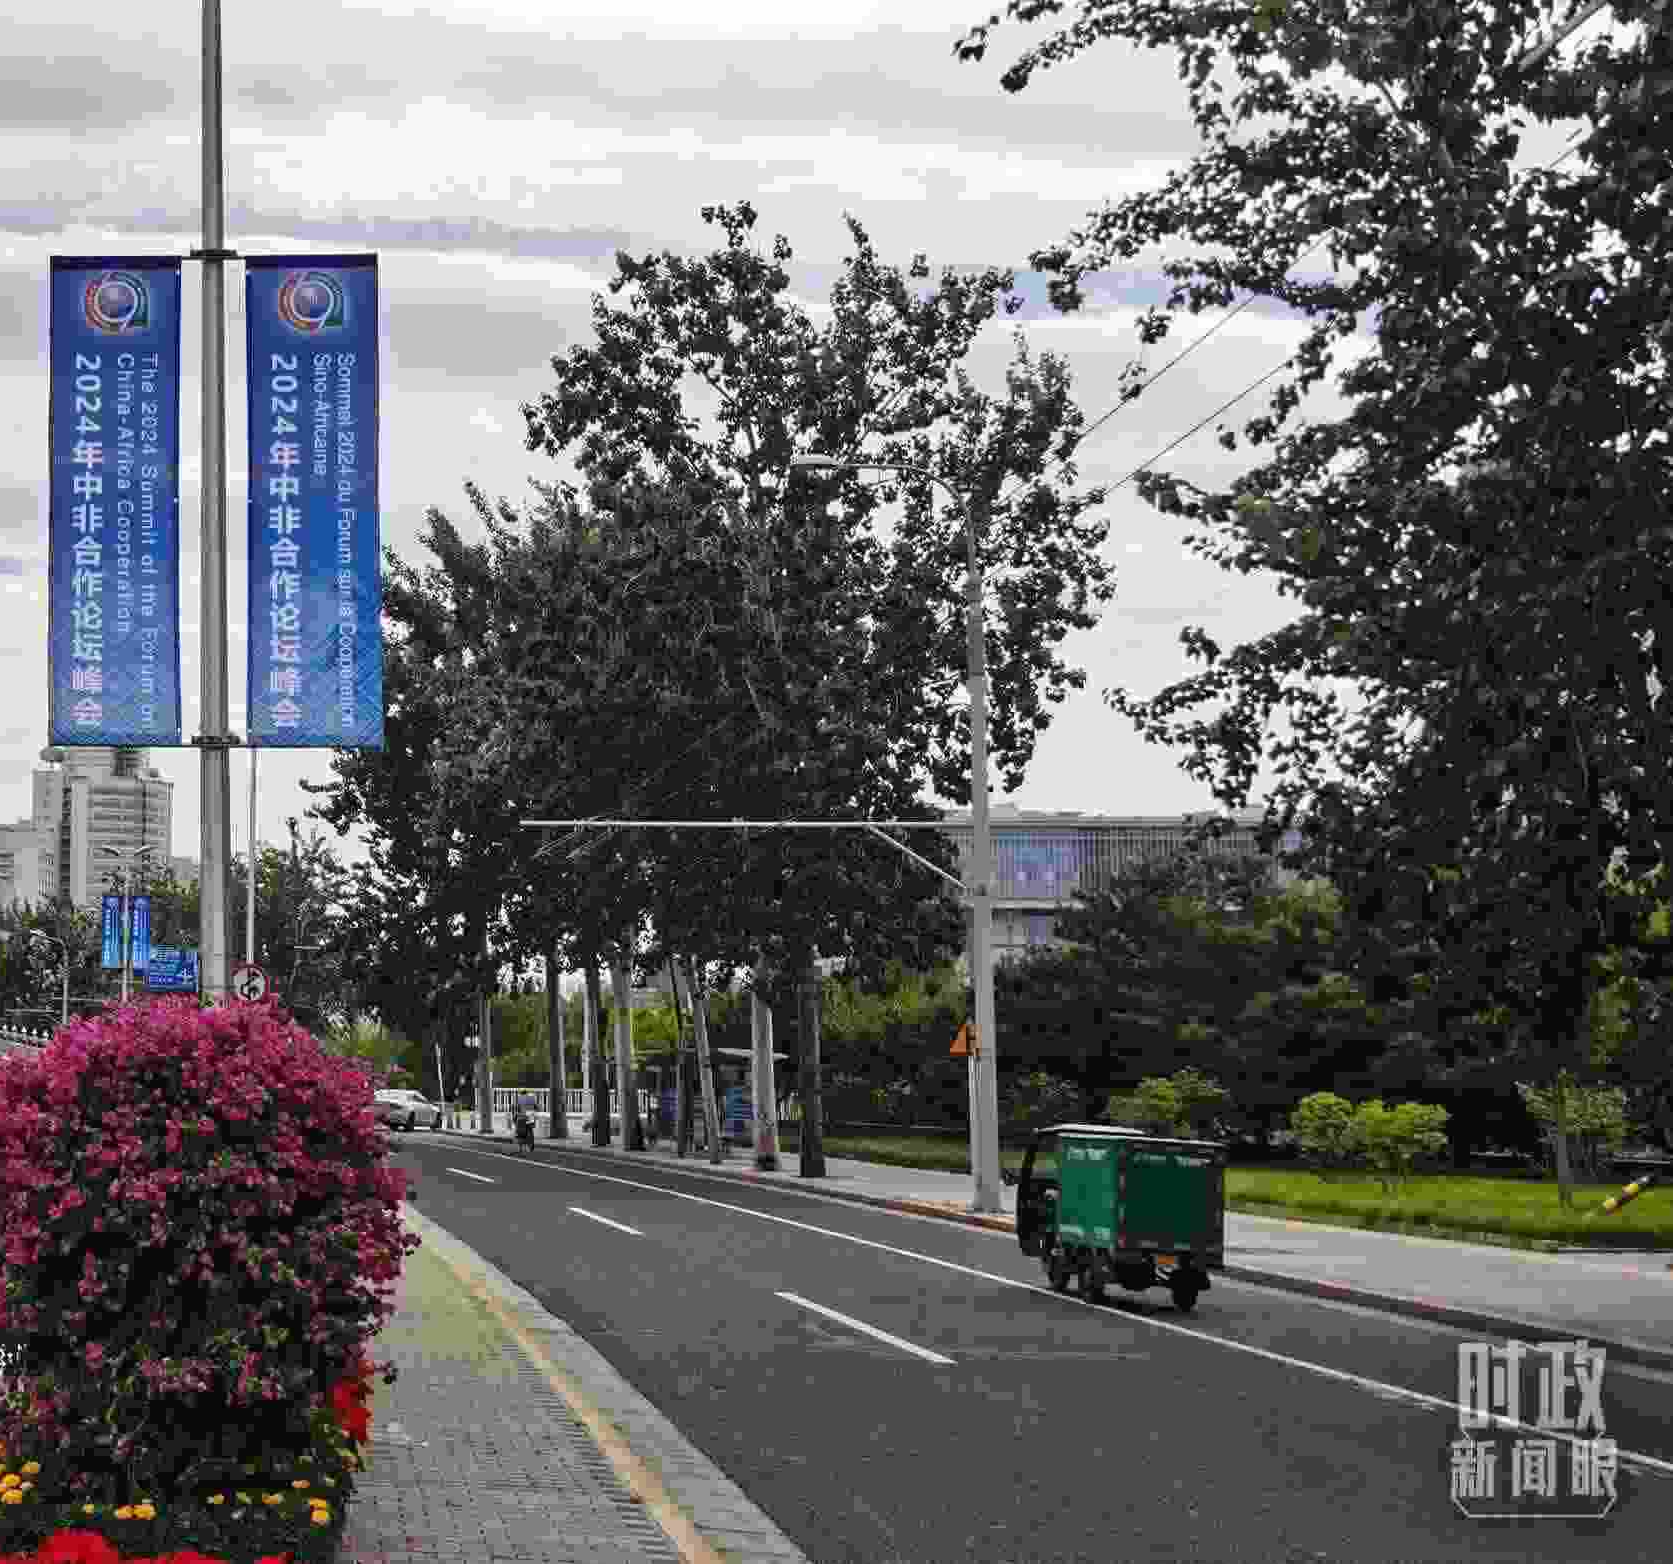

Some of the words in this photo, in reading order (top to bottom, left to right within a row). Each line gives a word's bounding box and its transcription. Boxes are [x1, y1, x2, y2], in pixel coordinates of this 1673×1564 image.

[140, 353, 158, 393] The
[117, 353, 134, 490] China-Africa
[140, 400, 158, 456] 2024
[337, 431, 357, 473] 2024
[140, 463, 158, 545] Summit
[337, 480, 356, 502] du
[71, 354, 103, 728] 2024年中非合作论坛峰会
[140, 553, 158, 576] of
[269, 354, 302, 729] 2024年中非合作论坛峰会
[338, 510, 357, 563] Forum
[117, 499, 134, 632] Cooperation
[140, 583, 158, 617] the
[140, 627, 158, 694] Forum
